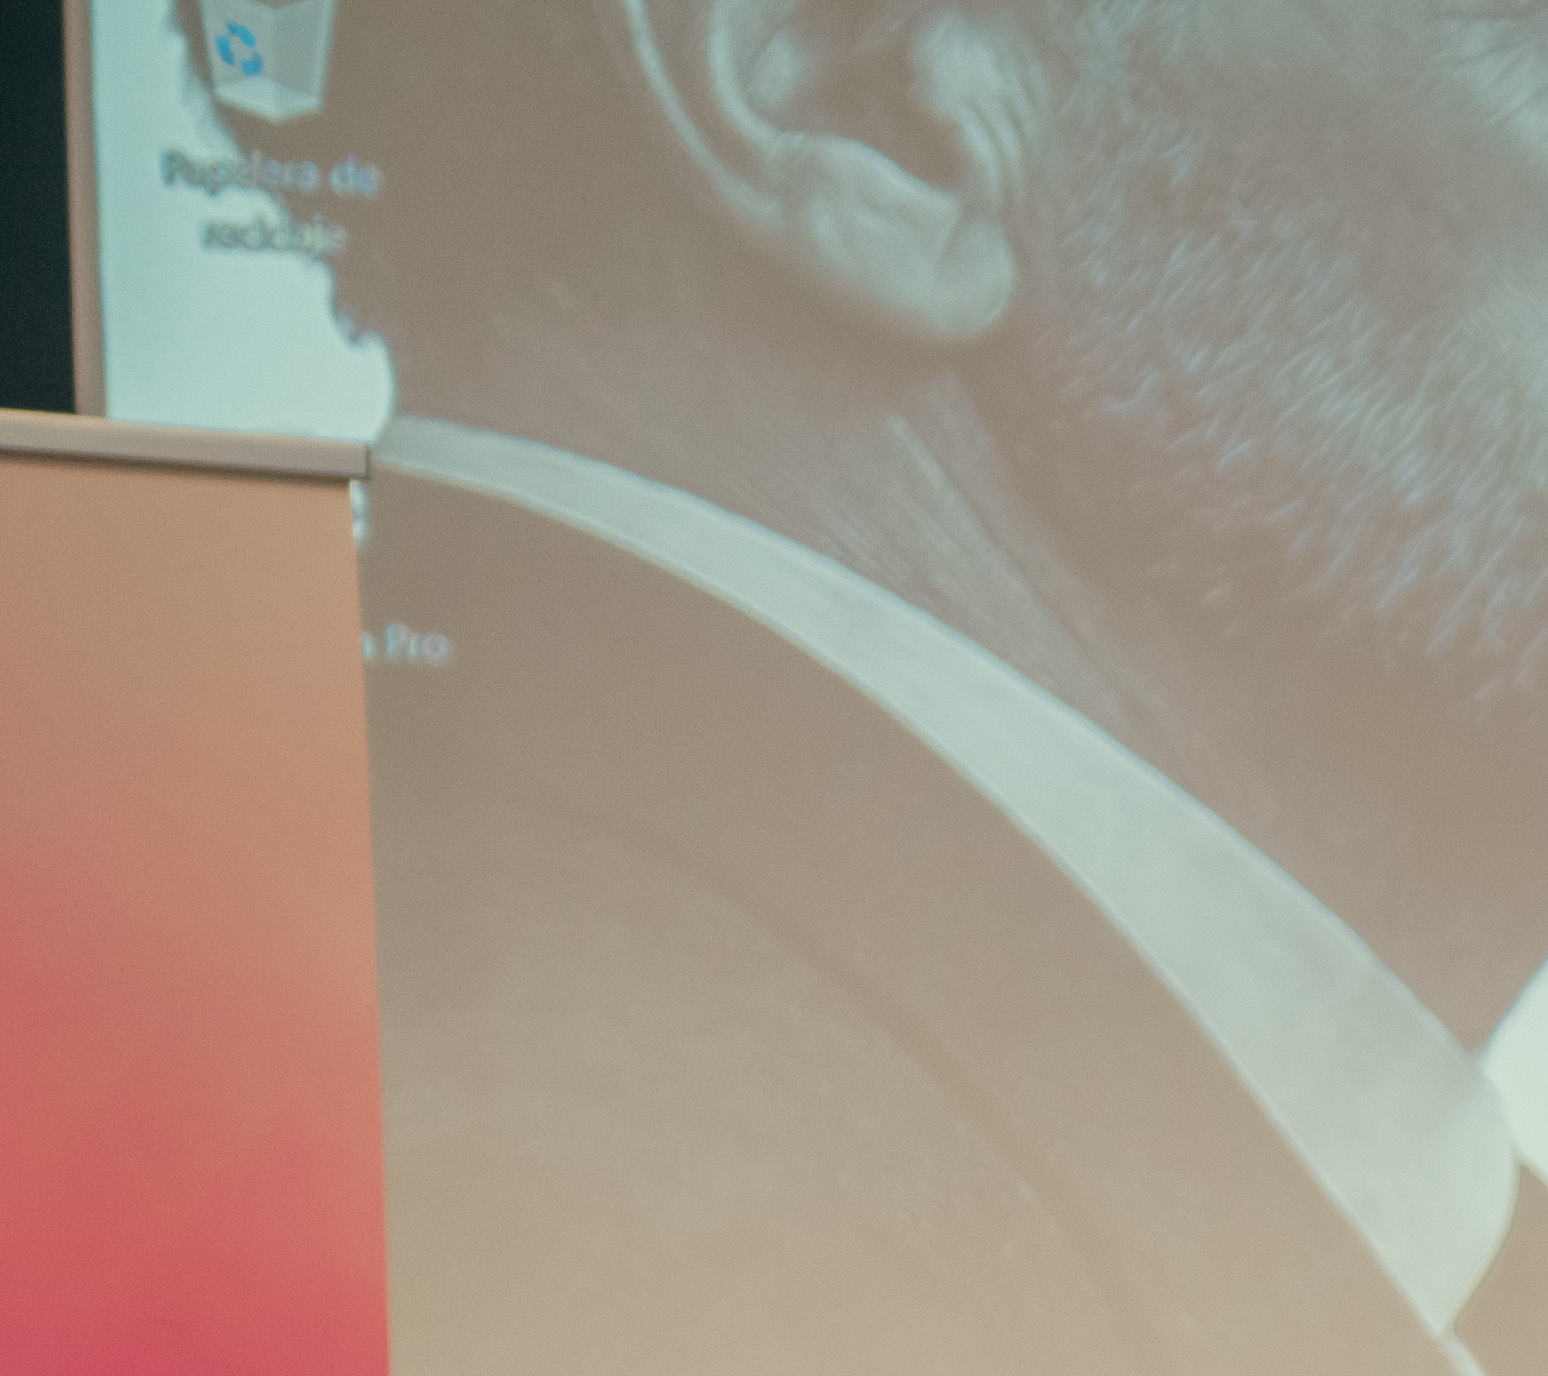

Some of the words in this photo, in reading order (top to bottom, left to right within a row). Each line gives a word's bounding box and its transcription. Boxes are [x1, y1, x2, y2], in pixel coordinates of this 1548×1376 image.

[162, 148, 321, 197] Papelera
[330, 154, 382, 197] de
[384, 621, 451, 667] Pro
